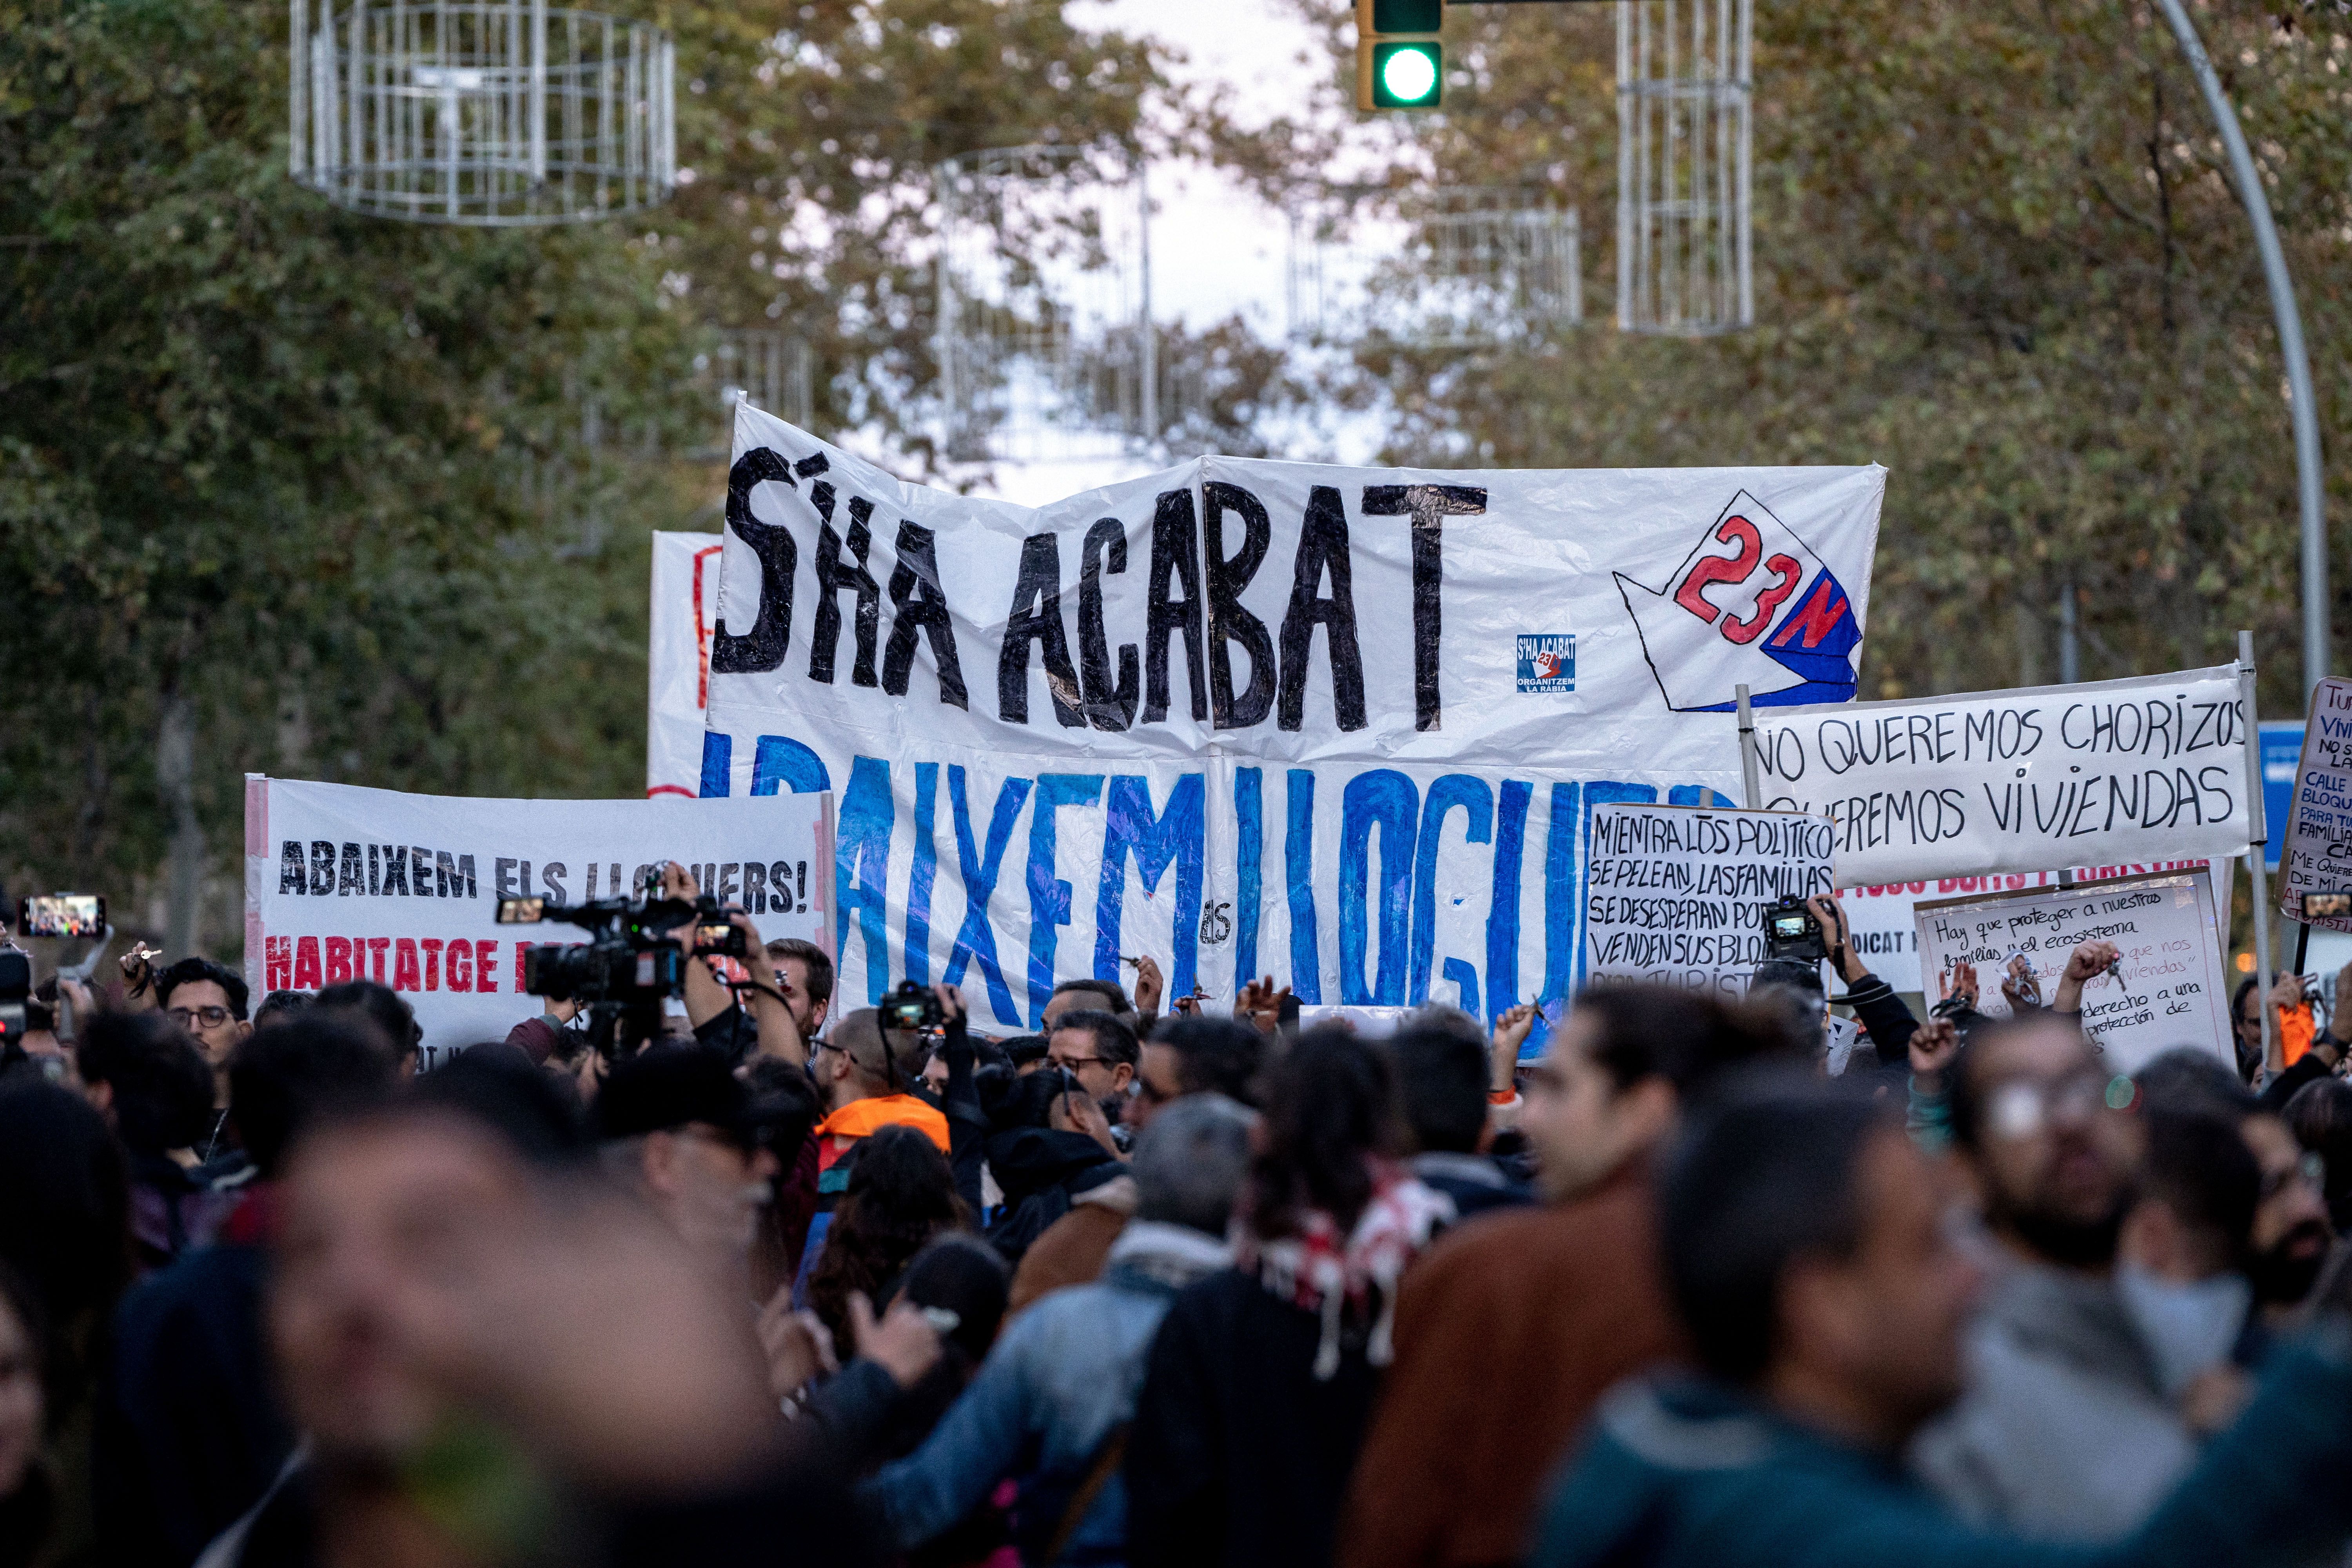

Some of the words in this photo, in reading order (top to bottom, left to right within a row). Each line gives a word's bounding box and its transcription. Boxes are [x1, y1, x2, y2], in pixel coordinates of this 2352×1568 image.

[711, 446, 968, 712] S'HA
[998, 481, 1488, 732] ACABAT
[1674, 515, 1849, 649] 23N
[1518, 638, 1538, 660] S'HA
[1540, 638, 1575, 659] ACABAT
[1755, 726, 1806, 782] NO
[1818, 708, 2042, 775] QUEREMOS
[2319, 739, 2340, 753] NO
[2305, 771, 2347, 792] CALLE
[1765, 788, 1964, 852] EREMOS
[1983, 764, 2234, 838] VIVIENDAS
[2300, 807, 2334, 824] PARA
[279, 840, 476, 898] ABAIXEM
[495, 857, 567, 906] ELS
[1590, 859, 1615, 886] SE
[2290, 850, 2314, 869] ME
[2290, 871, 2313, 886] DE
[1589, 895, 1616, 926] SE
[1619, 895, 1729, 931] DESESPERAN
[1935, 919, 1969, 951] Hay
[1976, 919, 2003, 943] que
[2007, 908, 2077, 939] proteger
[2083, 904, 2098, 917] a
[2102, 892, 2161, 915] nuestras
[1851, 931, 1904, 954] DICAT
[1944, 944, 2001, 976] familias
[2044, 919, 2139, 951] ecosistema
[2129, 944, 2153, 965] que
[2161, 938, 2192, 952] nos
[265, 935, 499, 993] HABITATGE
[2122, 956, 2197, 982] iviendas"
[2082, 994, 2149, 1019] derecho
[2157, 987, 2171, 1000] a
[2175, 982, 2202, 995] una
[2085, 1009, 2154, 1043] protección
[2166, 1000, 2192, 1015] de
